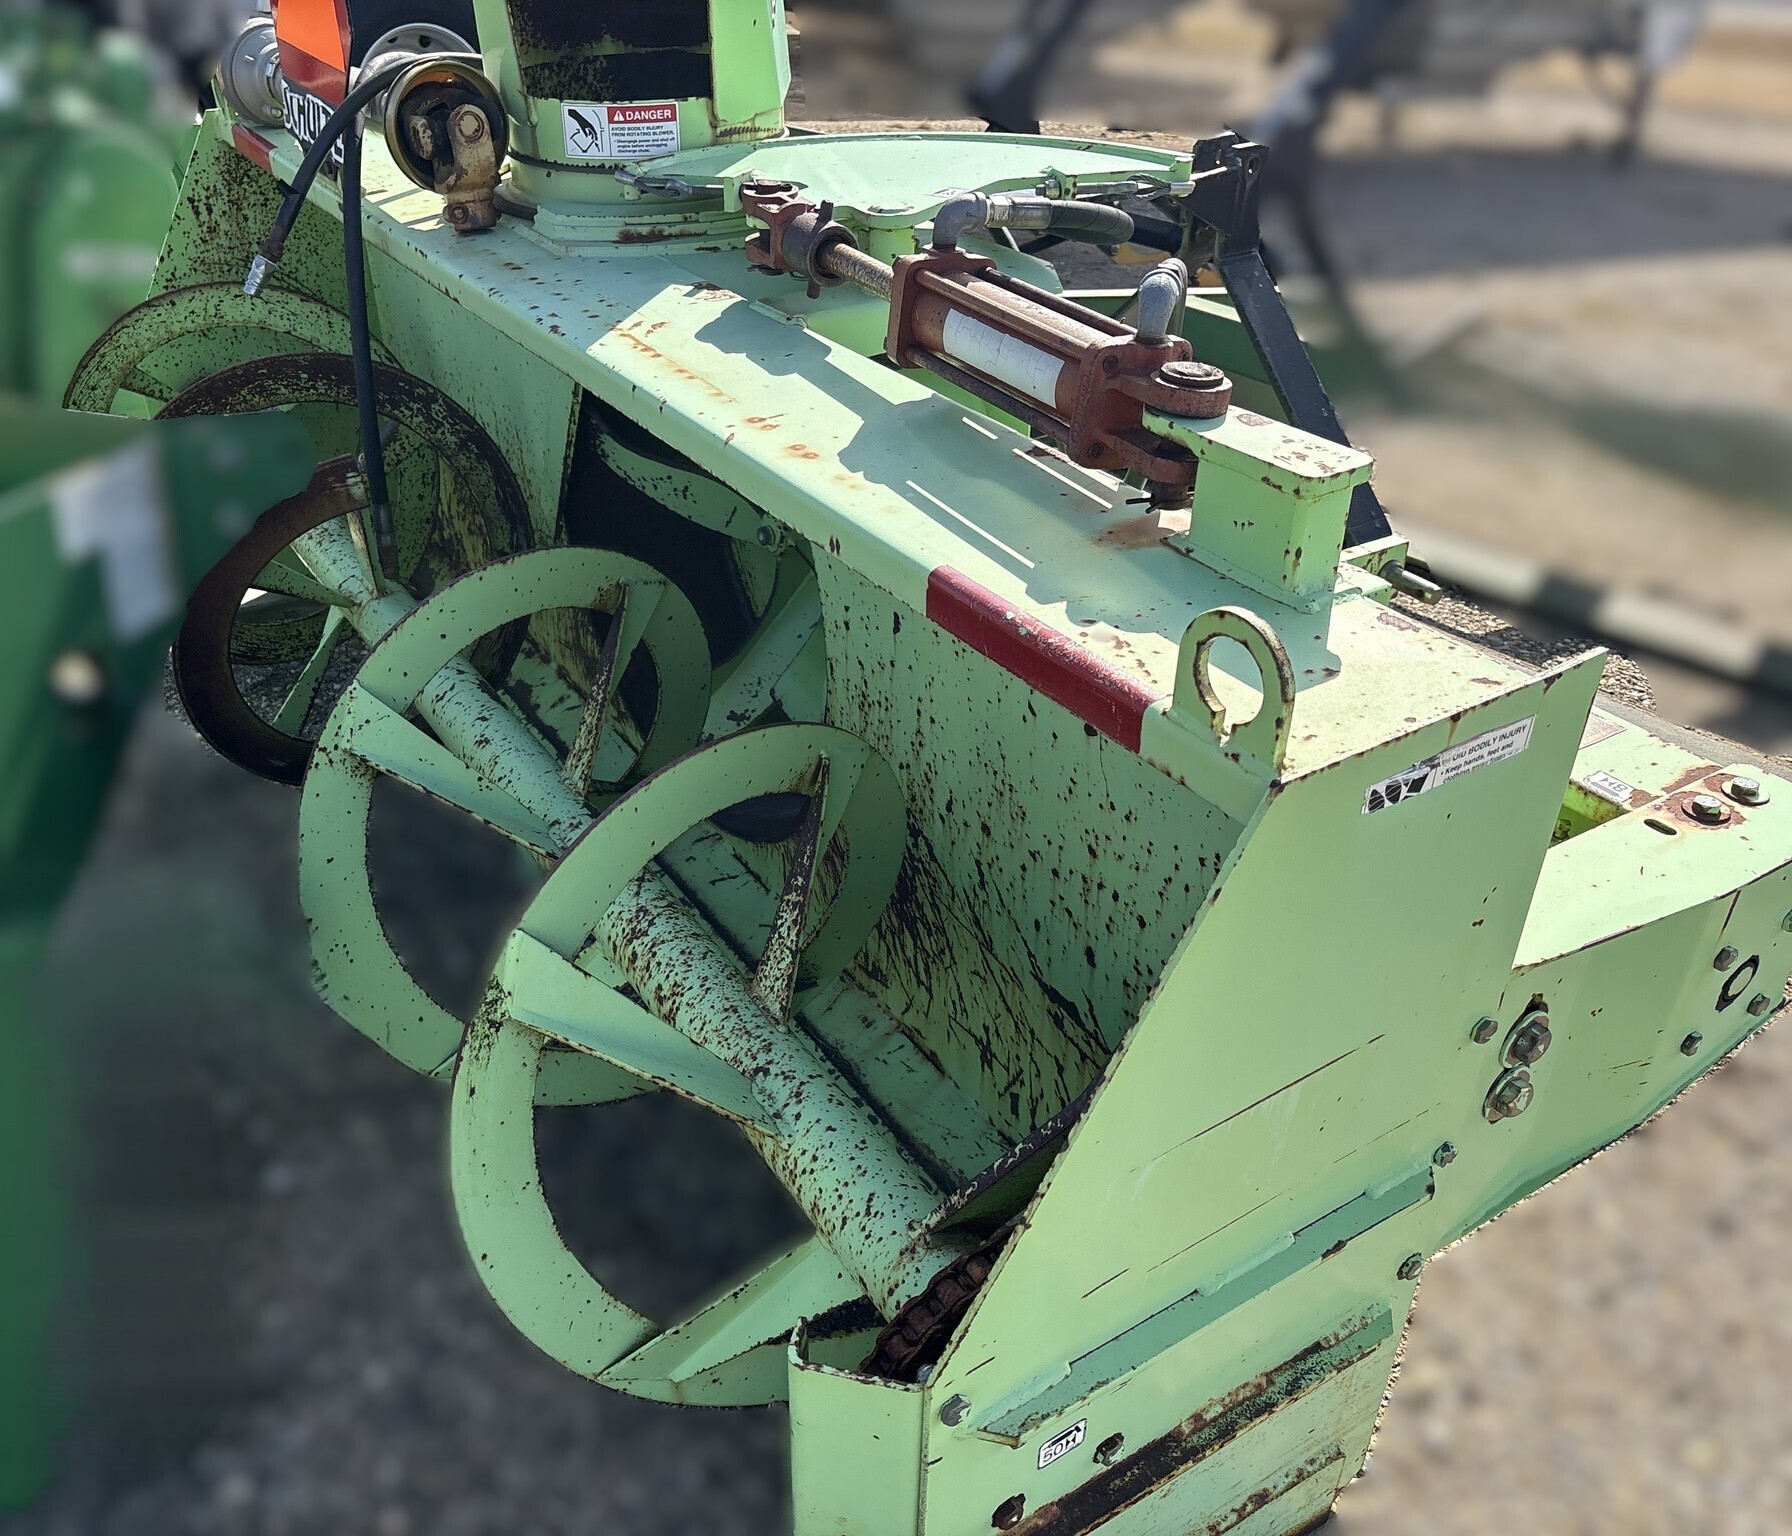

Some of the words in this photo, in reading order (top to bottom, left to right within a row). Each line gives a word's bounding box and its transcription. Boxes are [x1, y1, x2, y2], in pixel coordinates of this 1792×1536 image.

[626, 109, 672, 121] DANGER
[1468, 736, 1498, 755] BODILY
[1498, 724, 1527, 742] INJURY
[1444, 763, 1463, 775] Keep
[1463, 753, 1485, 767] hands,
[1487, 747, 1500, 757] feet
[1500, 741, 1514, 752] and
[1043, 1443, 1063, 1462] 50
